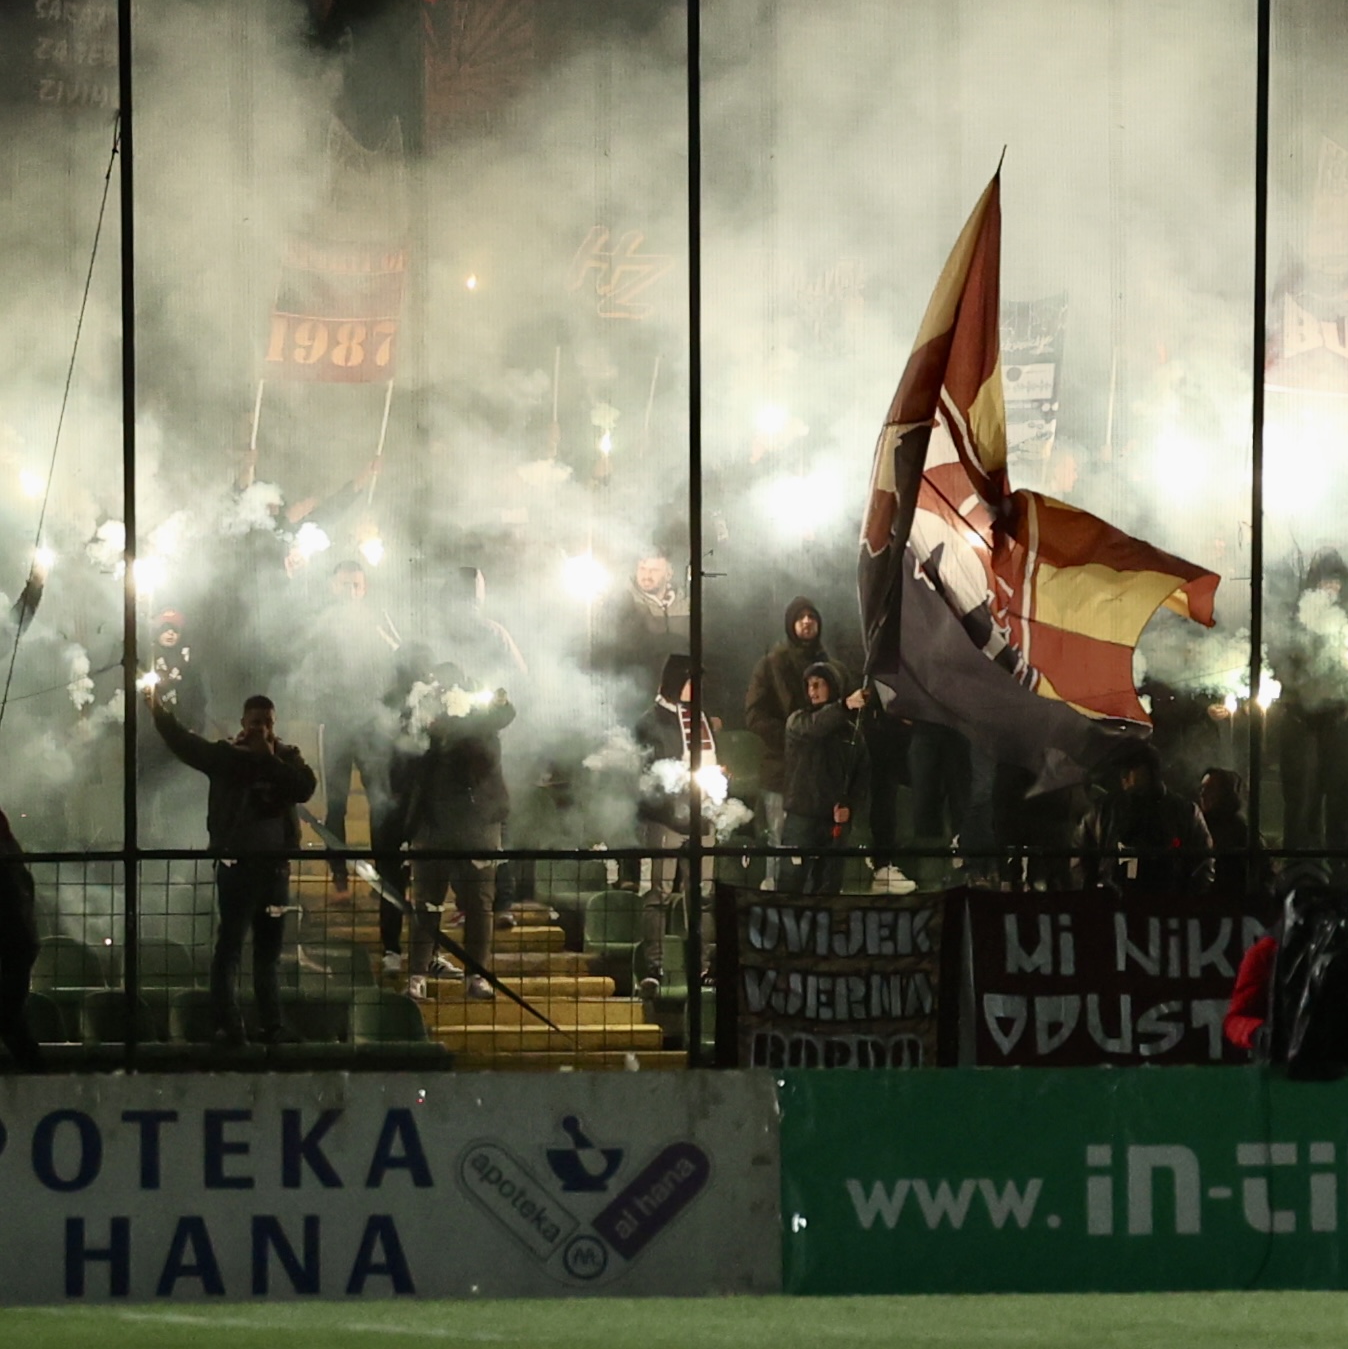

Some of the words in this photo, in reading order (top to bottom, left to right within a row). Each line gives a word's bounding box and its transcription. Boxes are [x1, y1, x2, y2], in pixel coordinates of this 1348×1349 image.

[265, 318, 398, 368] 1987
[749, 905, 934, 957] UVIJEK
[743, 969, 933, 1021] VJERNA
[983, 992, 1245, 1060] ODUST
[0, 1108, 434, 1191] OTEKA
[470, 1152, 562, 1244] apoteka
[635, 1156, 697, 1218] hana
[64, 1213, 417, 1298] HANA
